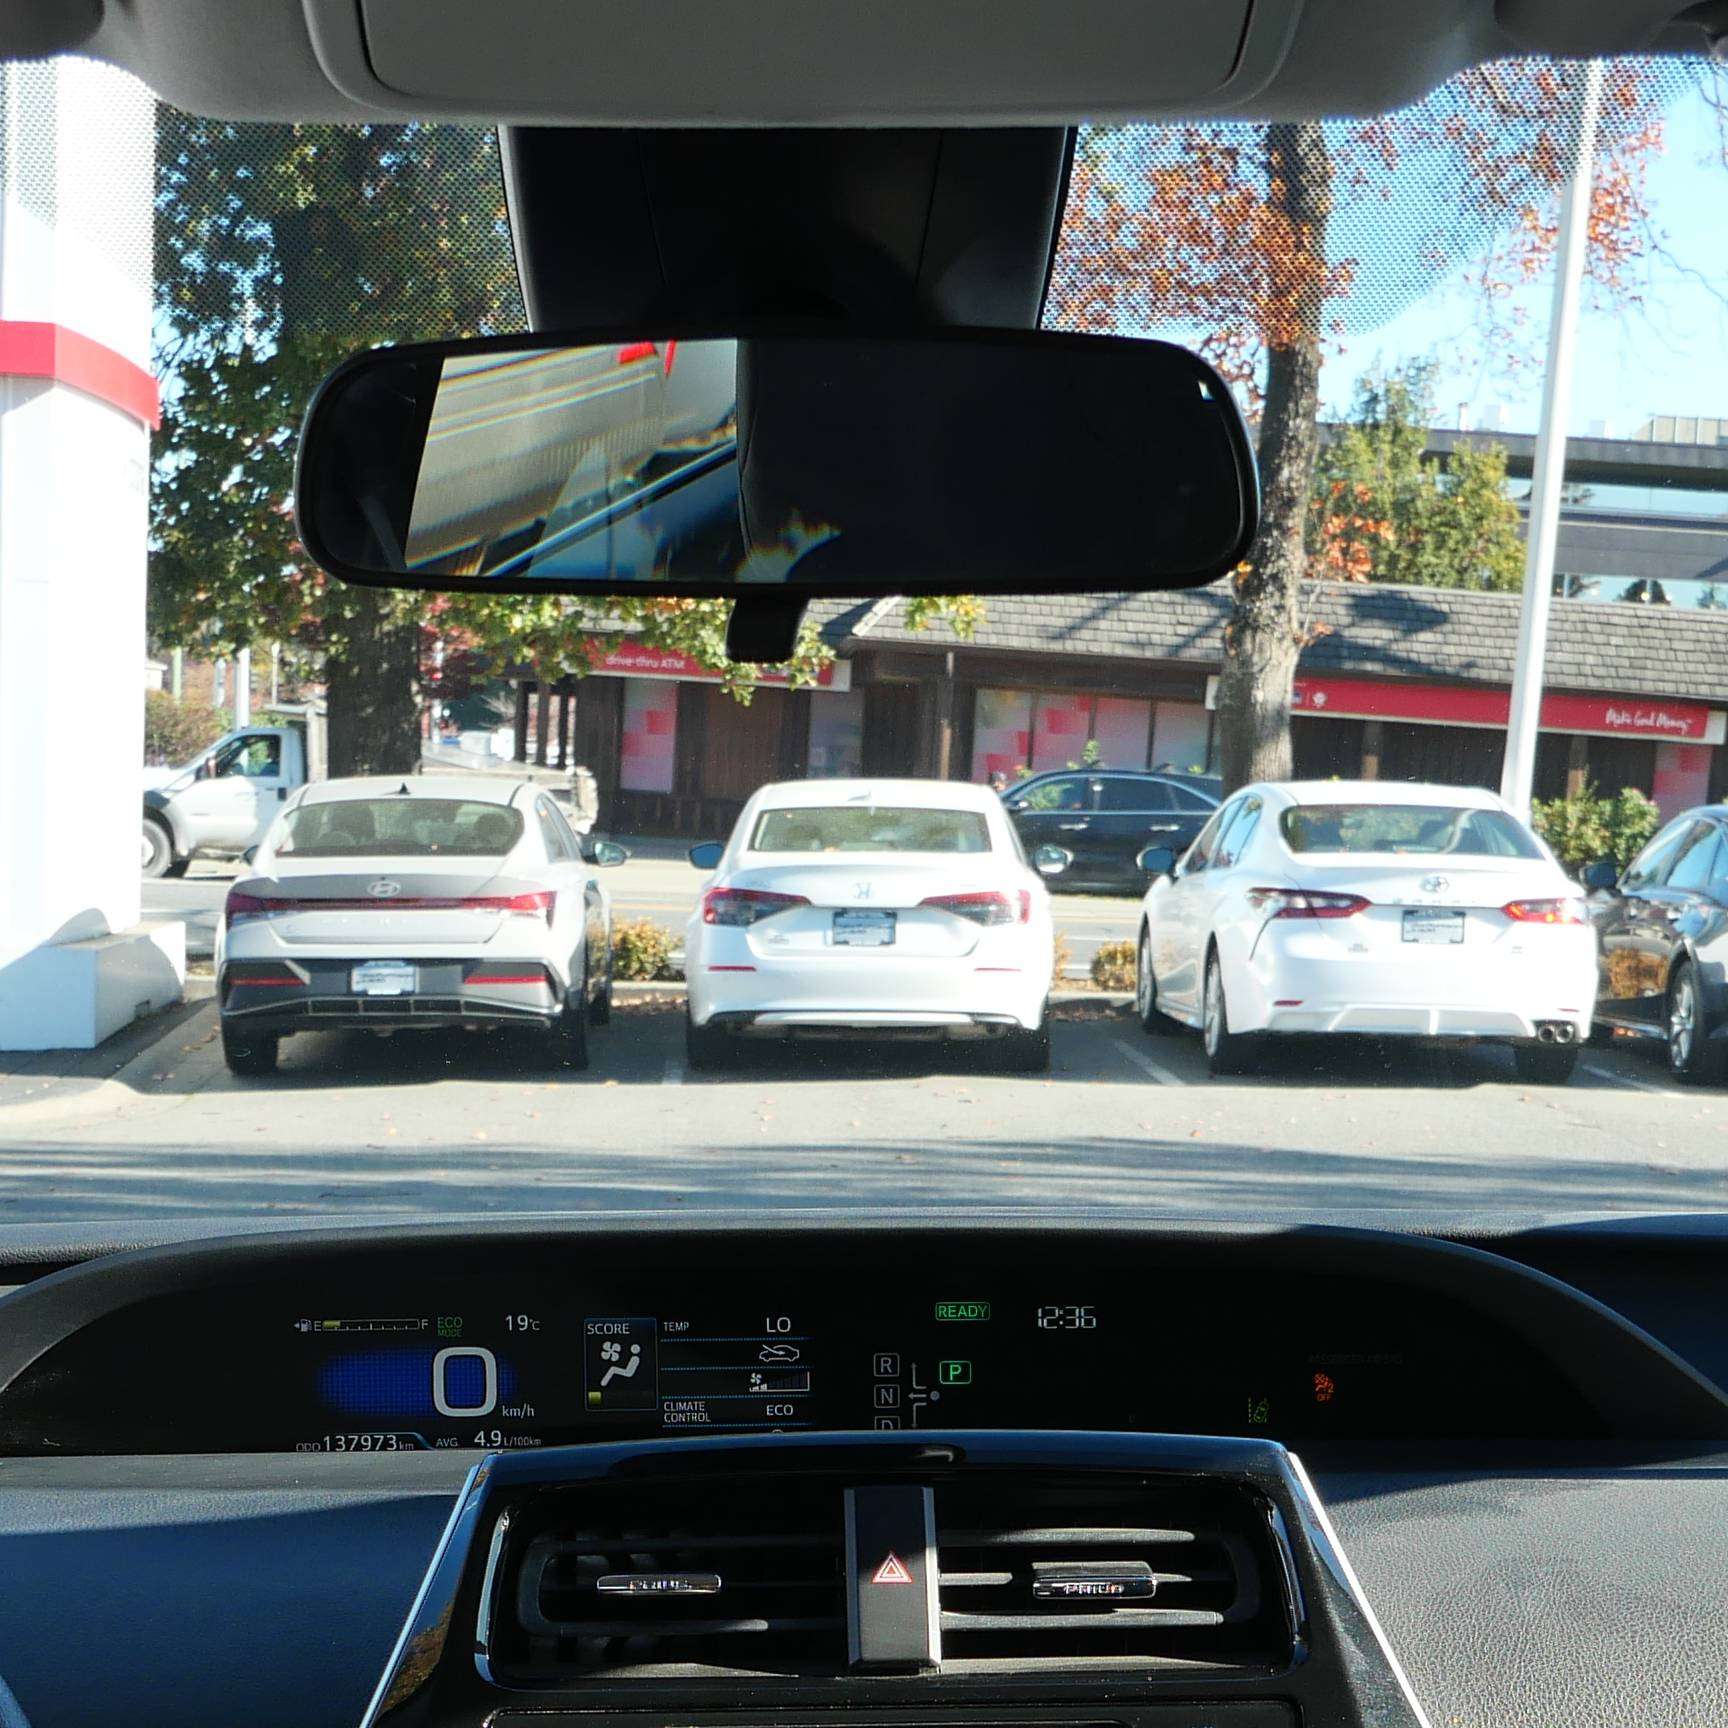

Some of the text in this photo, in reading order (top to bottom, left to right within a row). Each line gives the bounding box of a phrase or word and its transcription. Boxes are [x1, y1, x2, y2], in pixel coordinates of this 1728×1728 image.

[605, 655, 686, 669] drive-thru ATM
[1605, 707, 1632, 728] Make
[1633, 710, 1655, 727] Good
[938, 1305, 988, 1318] READY
[1037, 1306, 1097, 1329] 12:36
[314, 1321, 323, 1332] E
[421, 1320, 429, 1330] F
[437, 1316, 463, 1329] ECO
[586, 1323, 631, 1335] SCORE
[663, 1321, 690, 1332] TEMP
[766, 1317, 792, 1333] LO
[437, 1329, 463, 1338] MODE
[880, 1357, 893, 1374] R
[949, 1364, 962, 1381] P
[433, 1346, 497, 1418] 0
[881, 1388, 894, 1405] N
[502, 1404, 535, 1419] km/h
[663, 1401, 705, 1412] CLIMATE
[766, 1404, 794, 1416] ECO
[663, 1412, 712, 1424] CONTROL
[296, 1442, 321, 1452] ODO
[322, 1435, 397, 1452] 137973
[435, 1430, 542, 1448] AVG 4.9 L/100km
